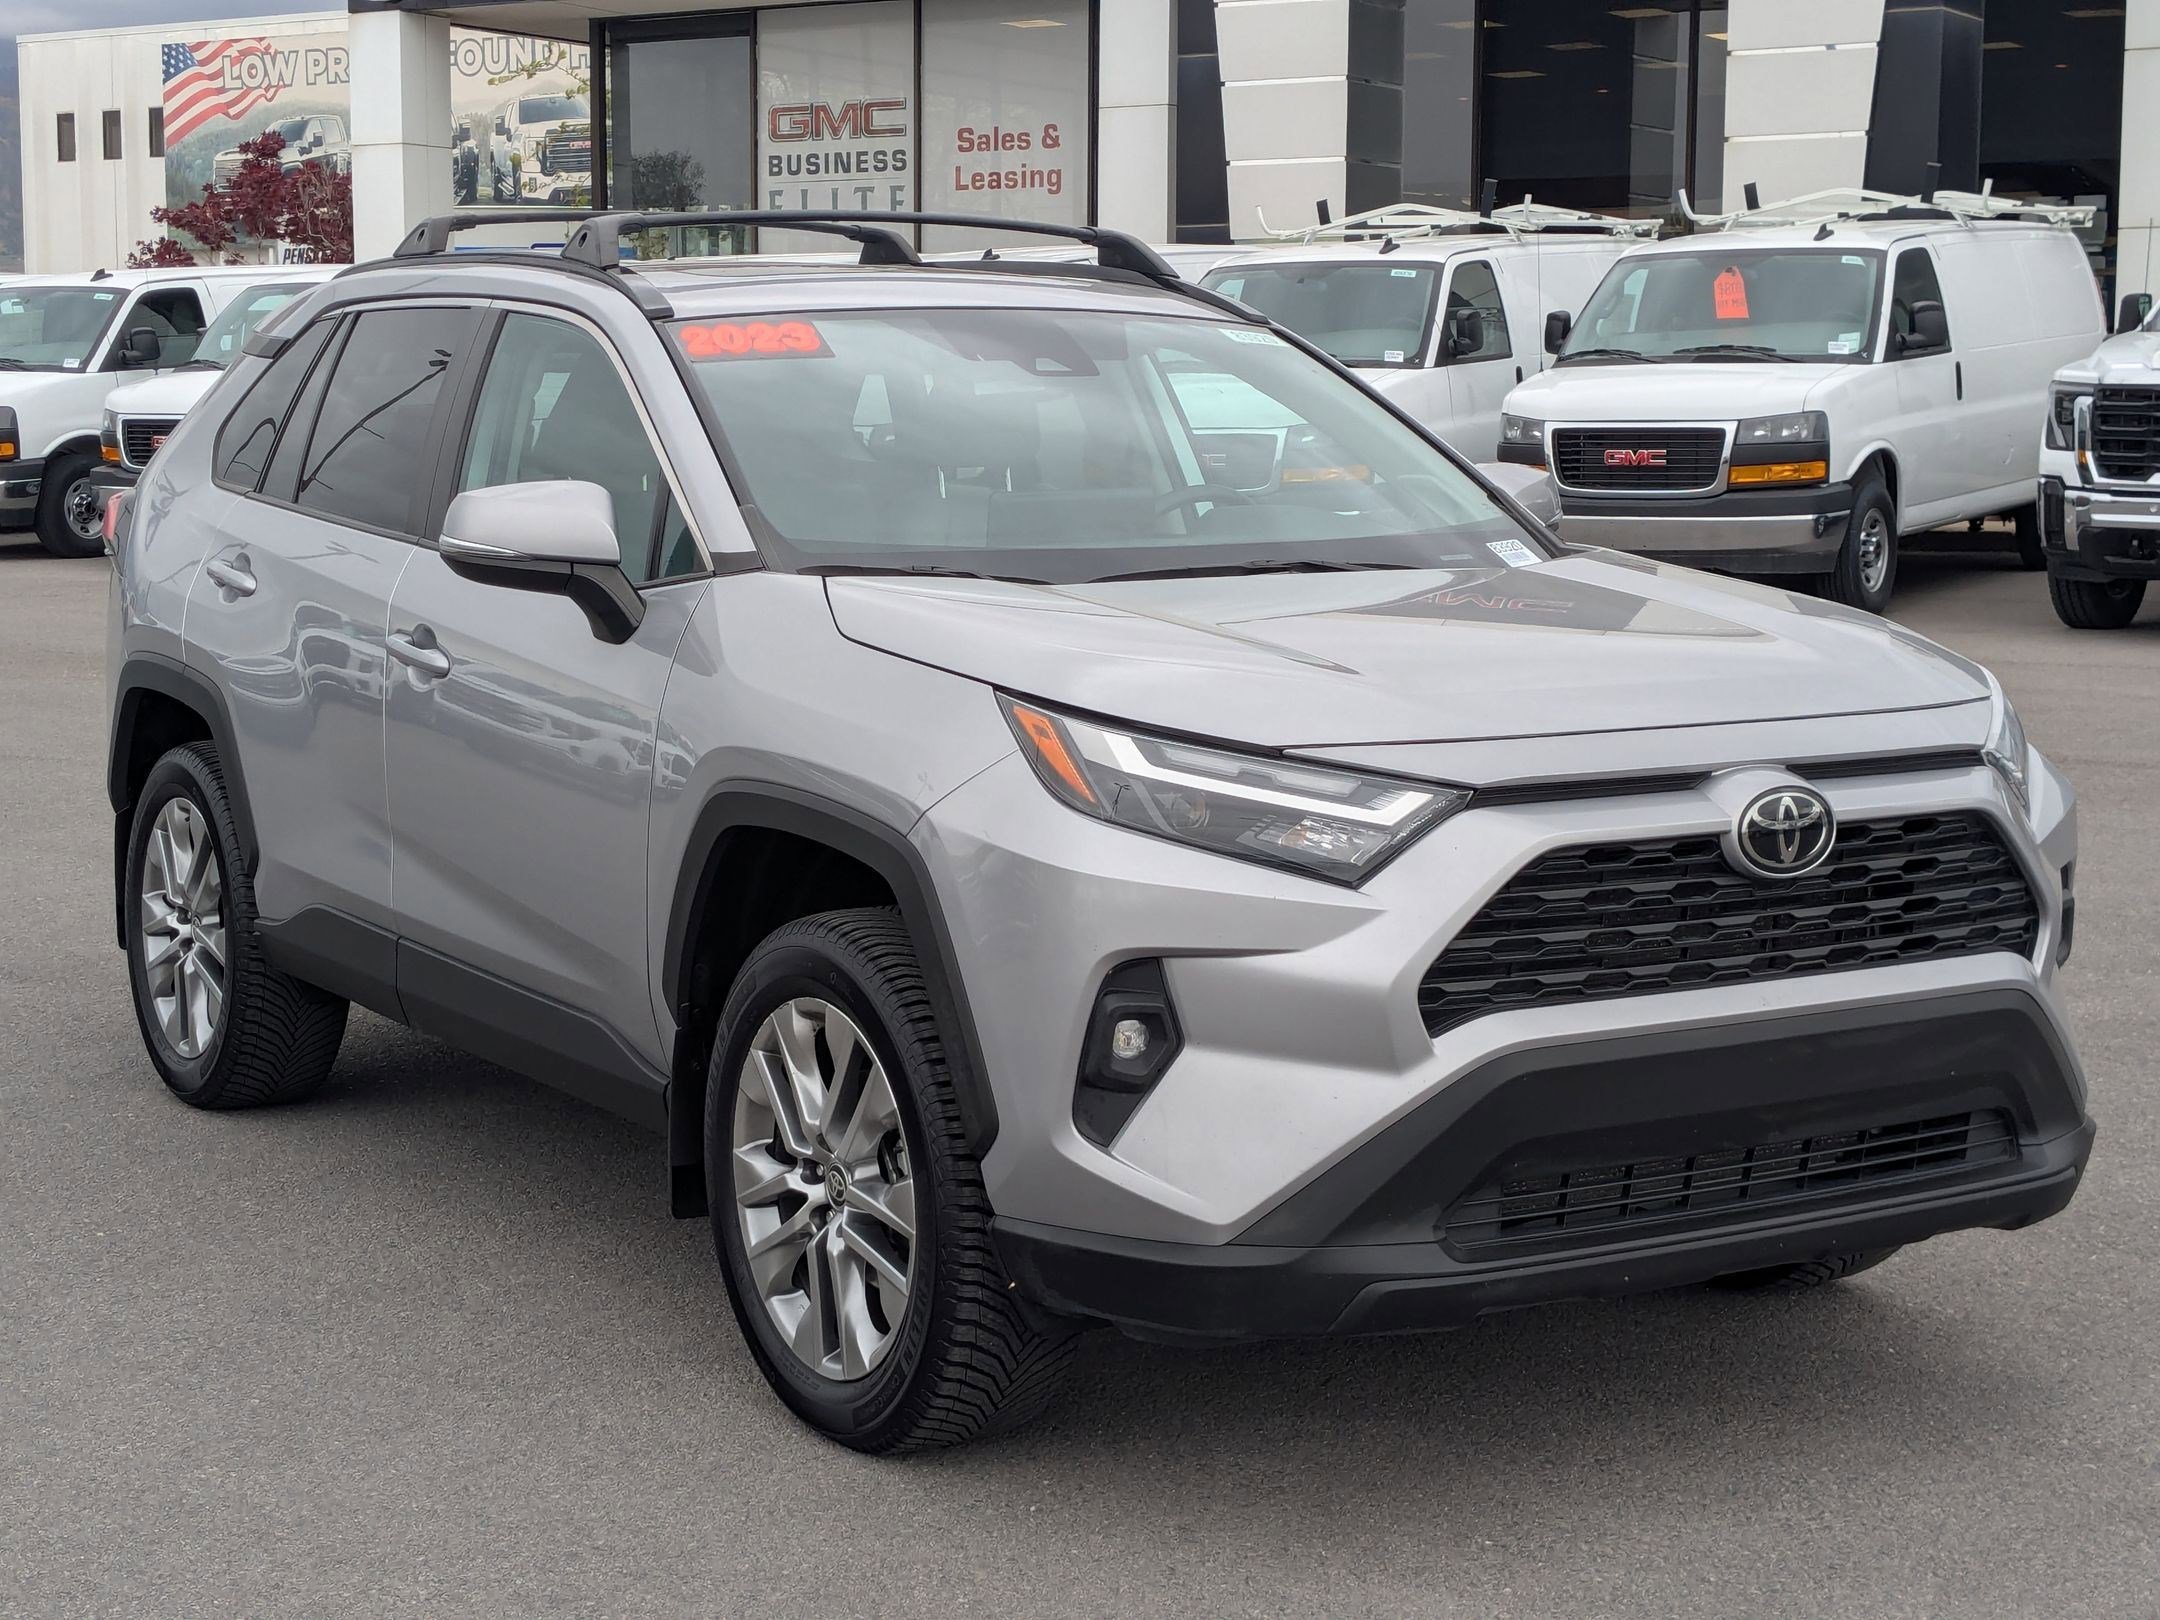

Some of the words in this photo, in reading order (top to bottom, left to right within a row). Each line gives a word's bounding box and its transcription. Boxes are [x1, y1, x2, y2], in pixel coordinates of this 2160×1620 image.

[221, 49, 299, 89] LOW
[768, 97, 906, 142] GMC
[957, 126, 1031, 153] Sales
[1041, 123, 1061, 149] &
[768, 149, 907, 176] BUSINESS
[955, 163, 1062, 195] Leasing
[1604, 449, 1667, 466] GMC
